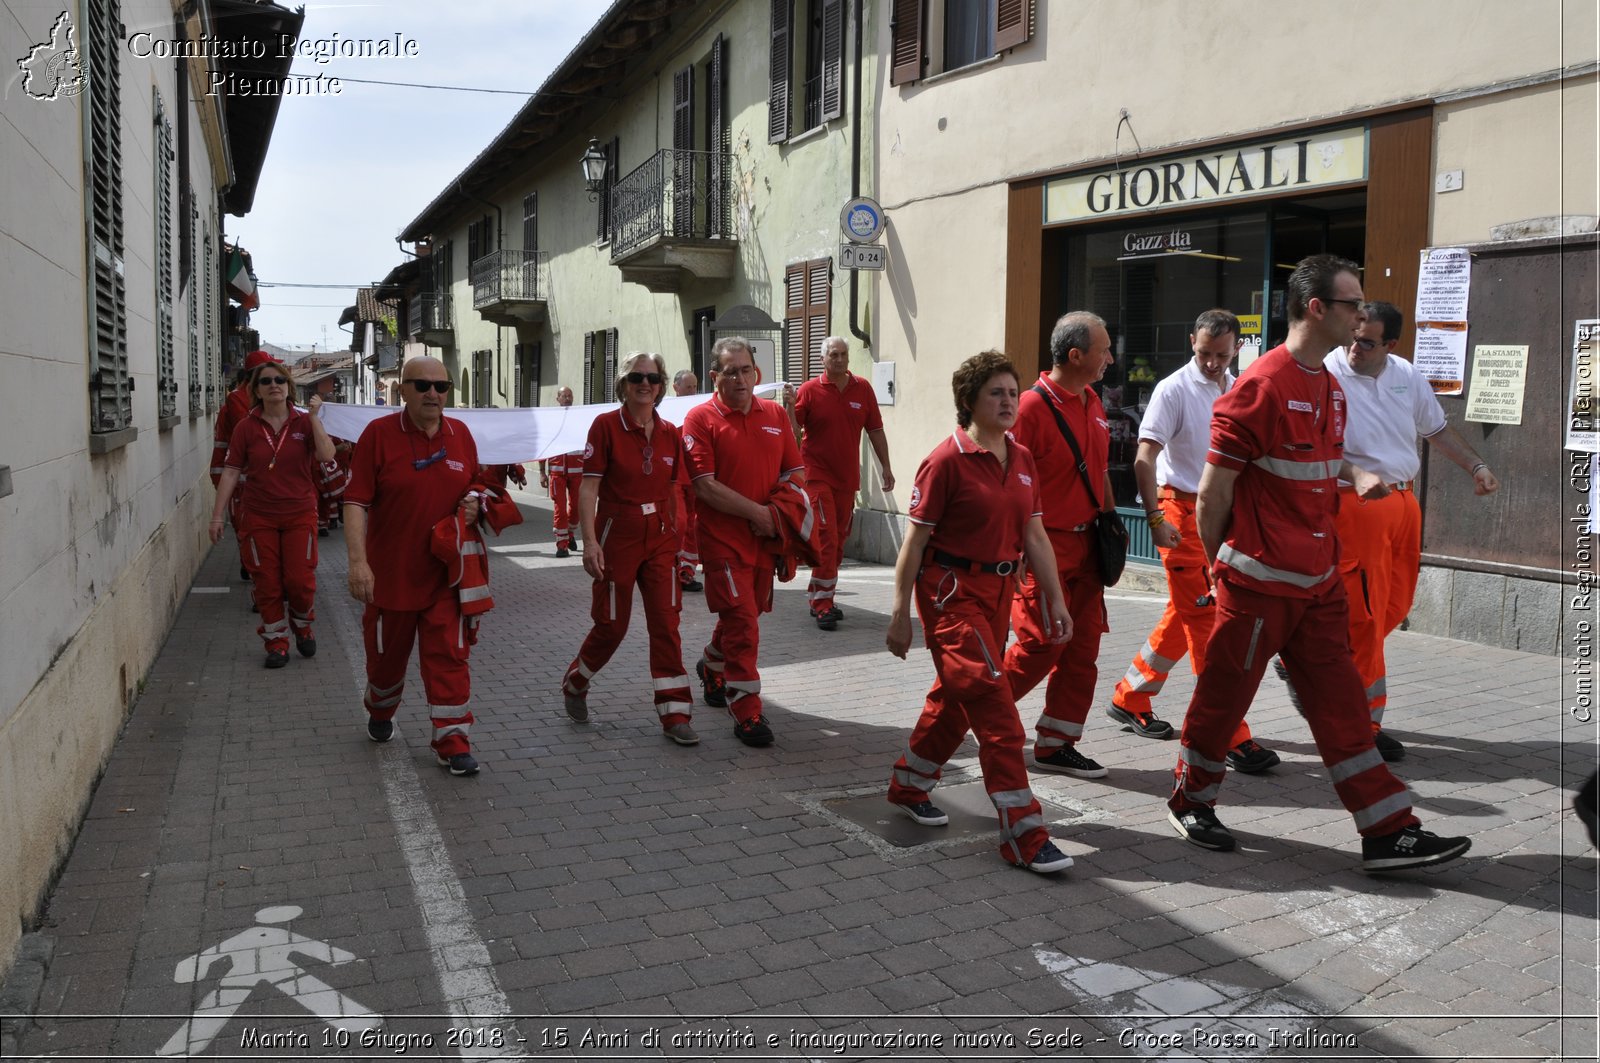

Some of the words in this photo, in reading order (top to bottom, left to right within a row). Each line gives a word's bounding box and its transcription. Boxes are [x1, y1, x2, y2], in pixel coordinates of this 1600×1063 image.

[1087, 139, 1313, 214] GIORNALI
[1445, 174, 1452, 189] 2
[1124, 229, 1192, 252] Gazzetta
